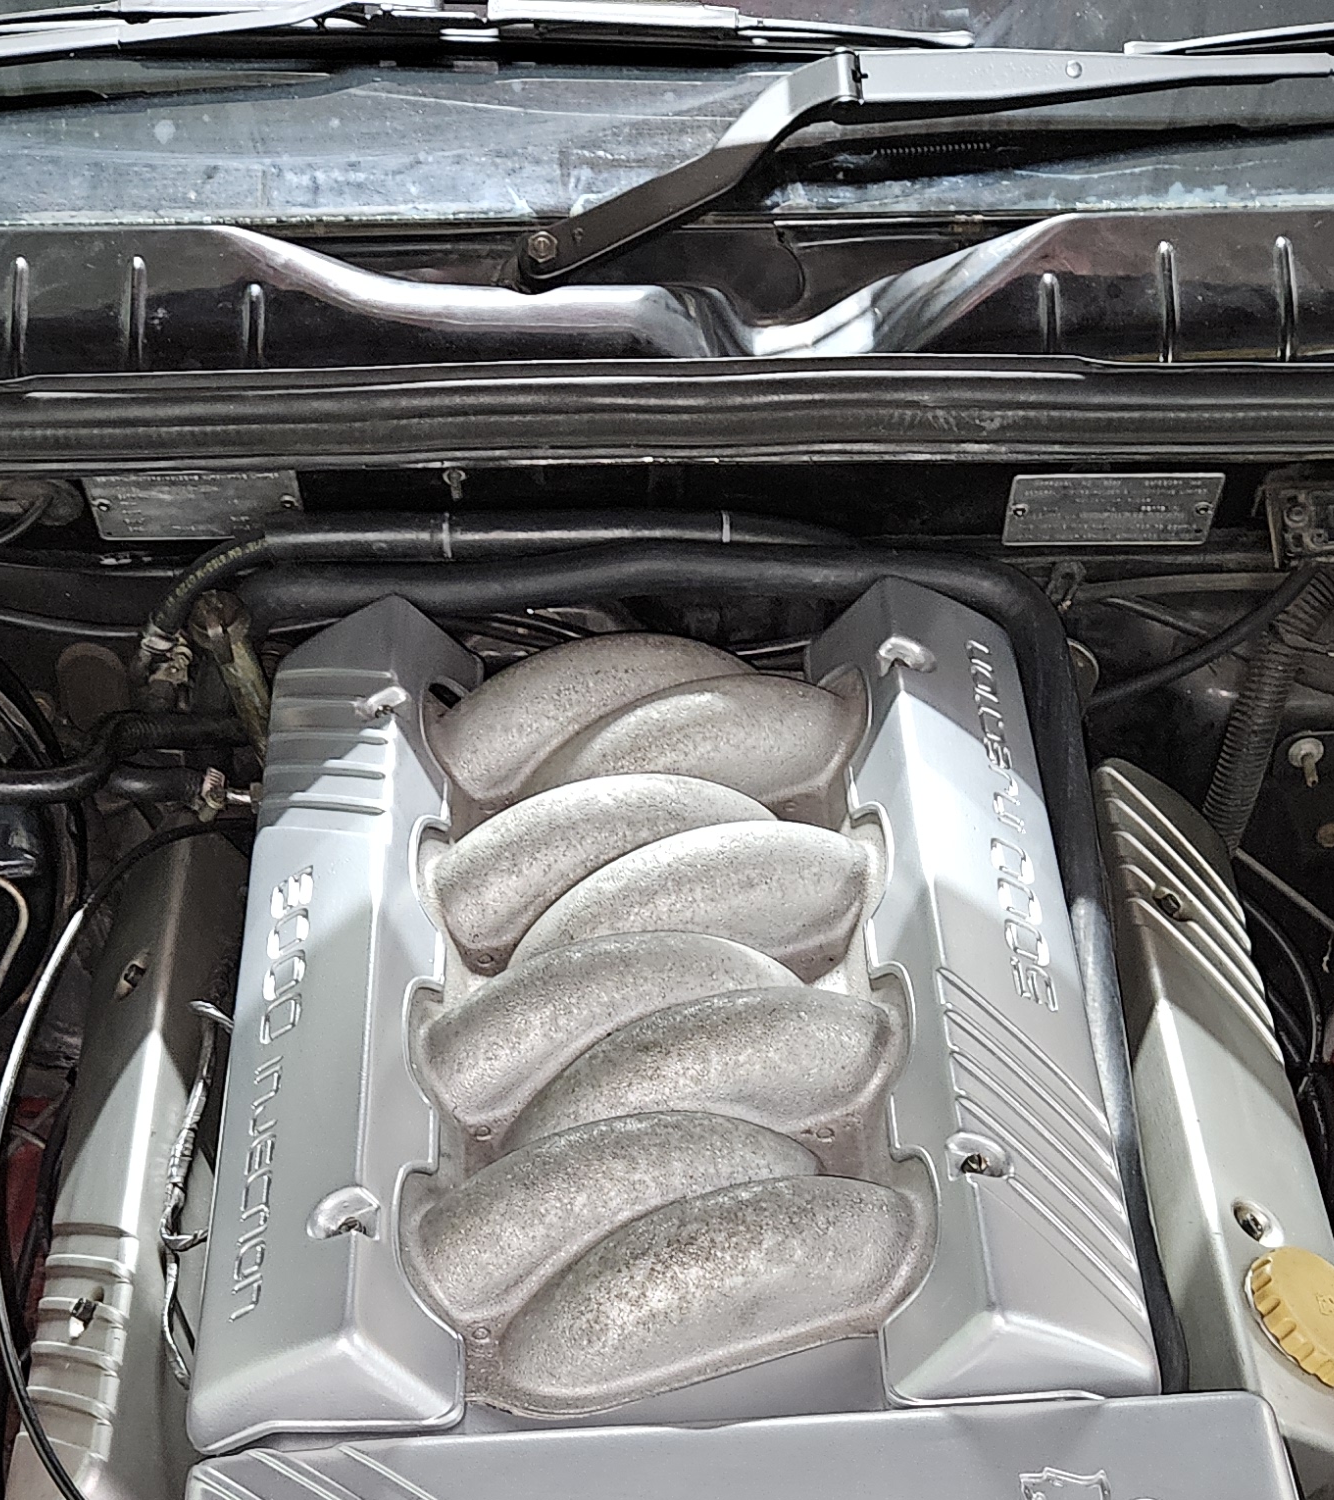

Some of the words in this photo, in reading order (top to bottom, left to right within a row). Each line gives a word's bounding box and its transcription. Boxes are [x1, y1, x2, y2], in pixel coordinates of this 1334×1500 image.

[967, 639, 1027, 834] INJECTION
[989, 836, 1059, 1012] 5000
[229, 1055, 284, 1323] INJECTION
